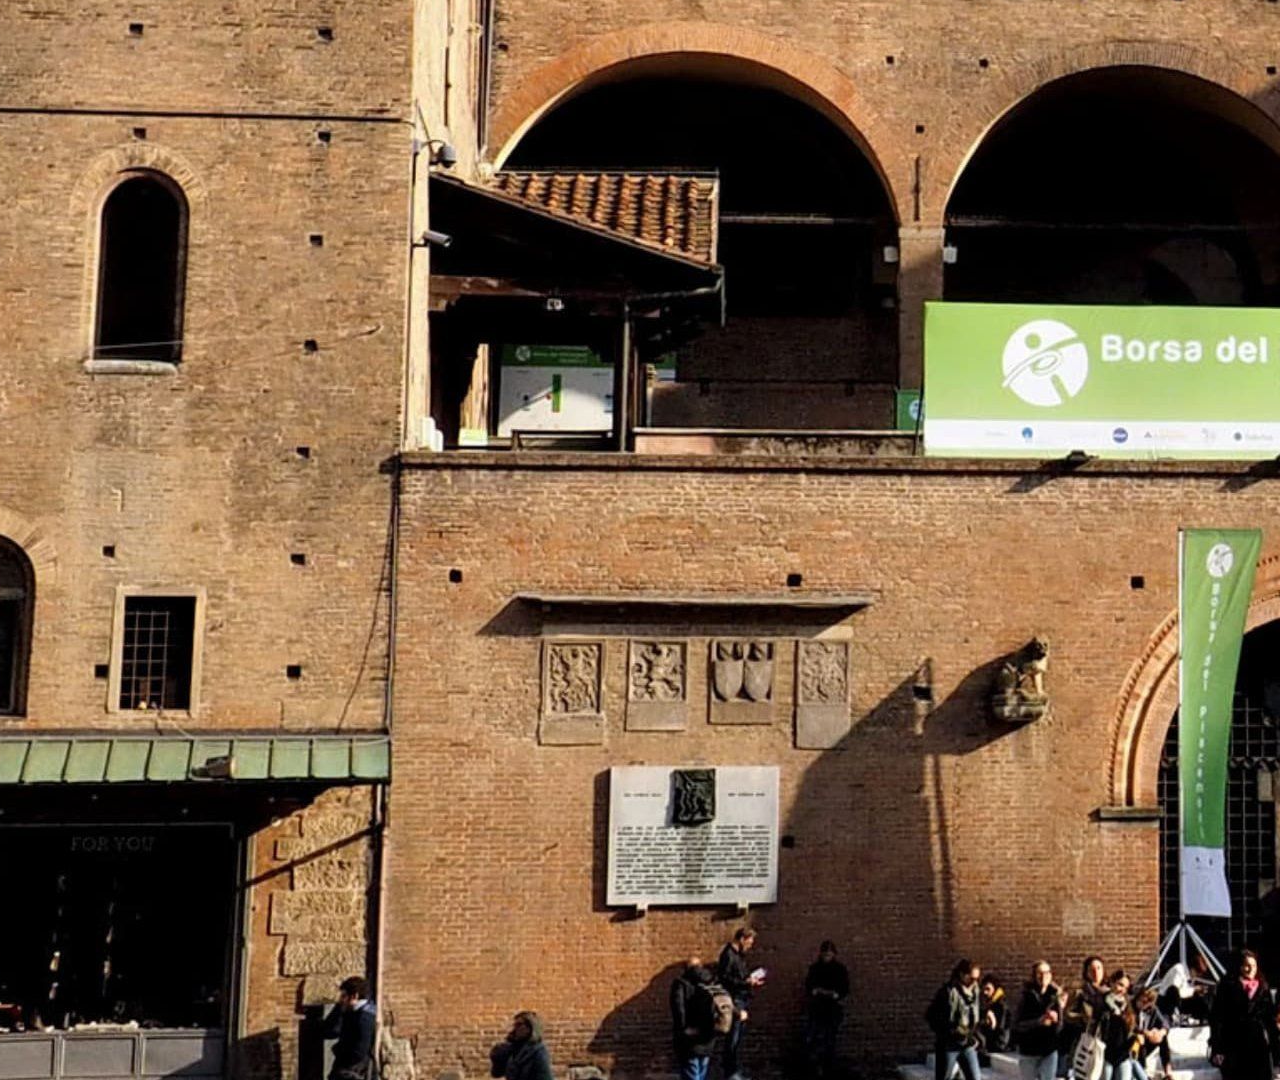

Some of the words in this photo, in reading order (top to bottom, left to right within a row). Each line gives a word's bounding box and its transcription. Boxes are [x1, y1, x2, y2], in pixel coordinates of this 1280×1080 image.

[1101, 334, 1202, 363] Borsa
[1216, 335, 1268, 363] del
[71, 836, 109, 852] FOR
[113, 836, 155, 852] YOU
